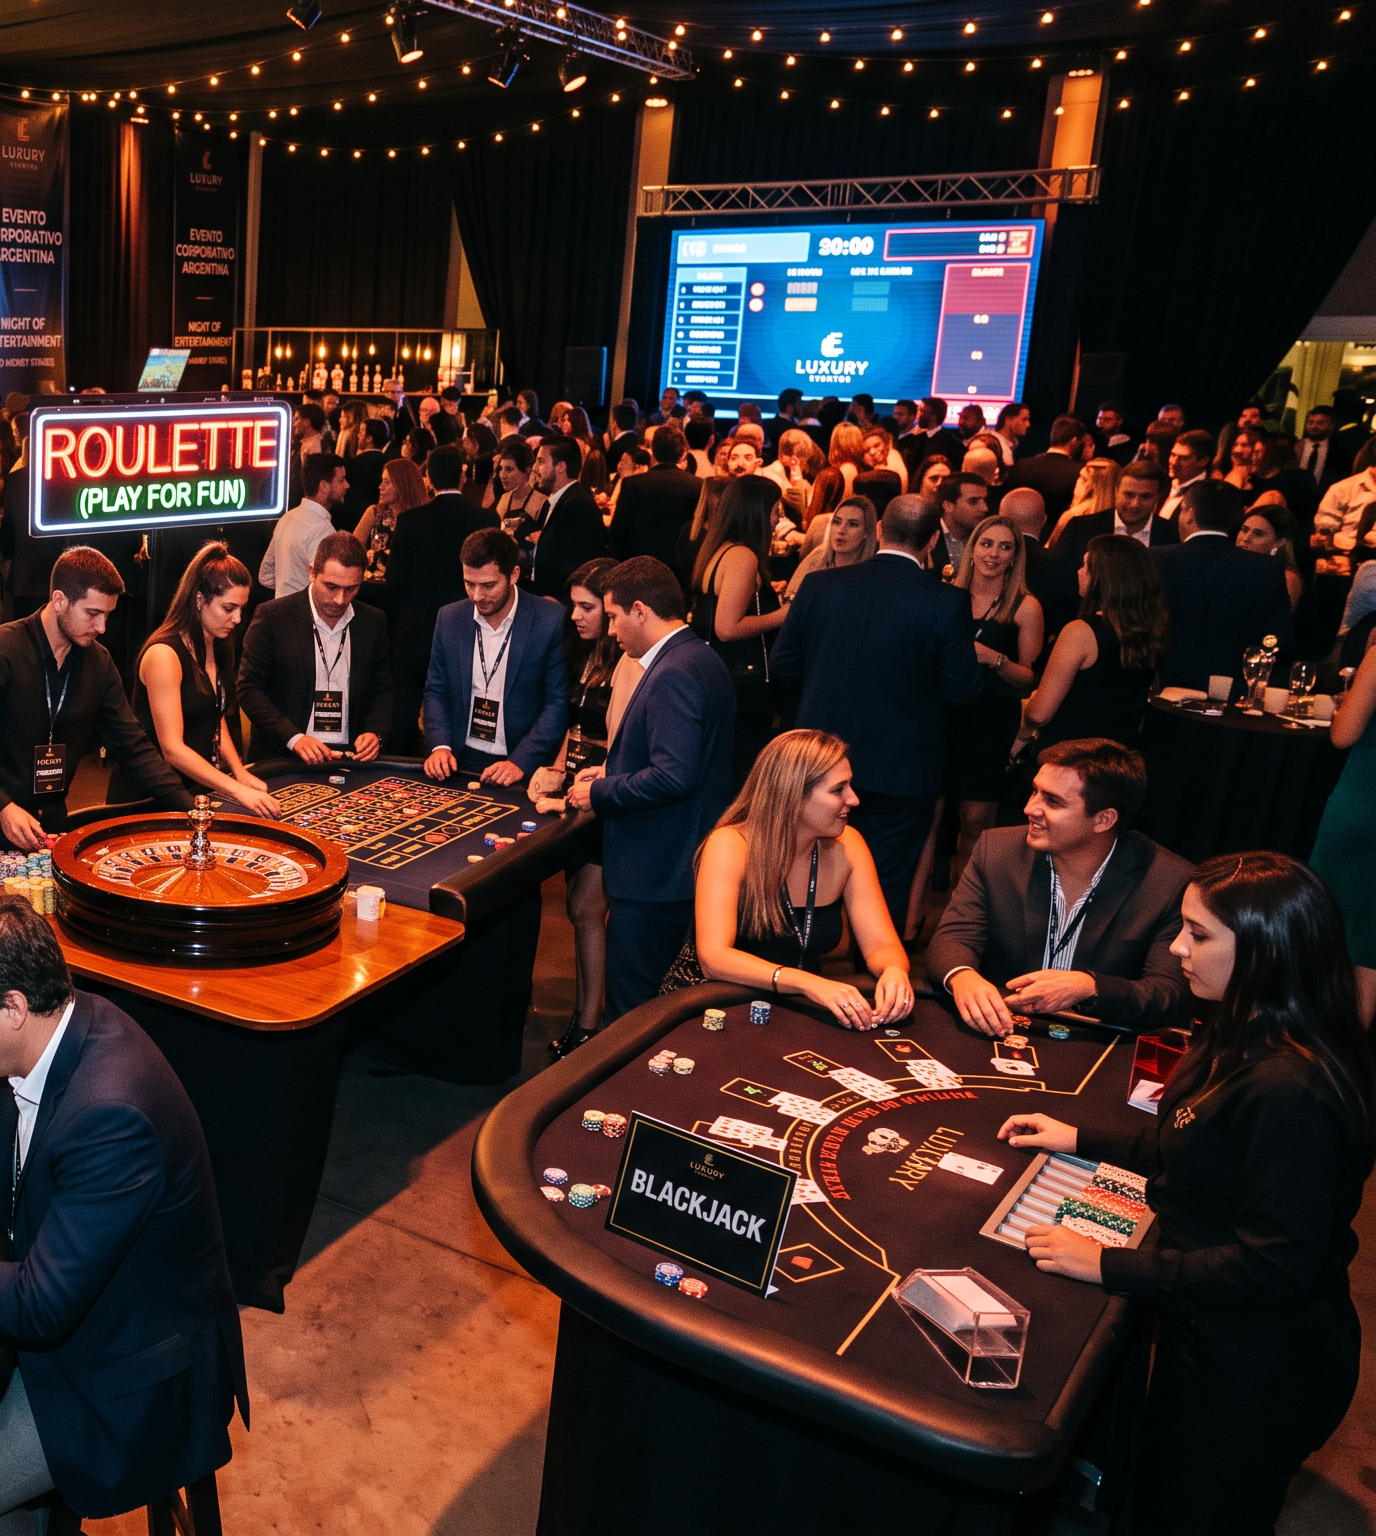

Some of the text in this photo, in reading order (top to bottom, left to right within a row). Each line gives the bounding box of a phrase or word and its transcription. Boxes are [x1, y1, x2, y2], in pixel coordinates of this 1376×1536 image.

[2, 207, 47, 226] EVENTO
[189, 227, 223, 243] EVENTO
[0, 316, 46, 330] NIGHT OF
[795, 358, 870, 376] LUXURY
[43, 419, 280, 480] ROULETTE
[79, 478, 248, 521] (PLAY FOR FUN)
[629, 1167, 767, 1245] BLACKJACK
